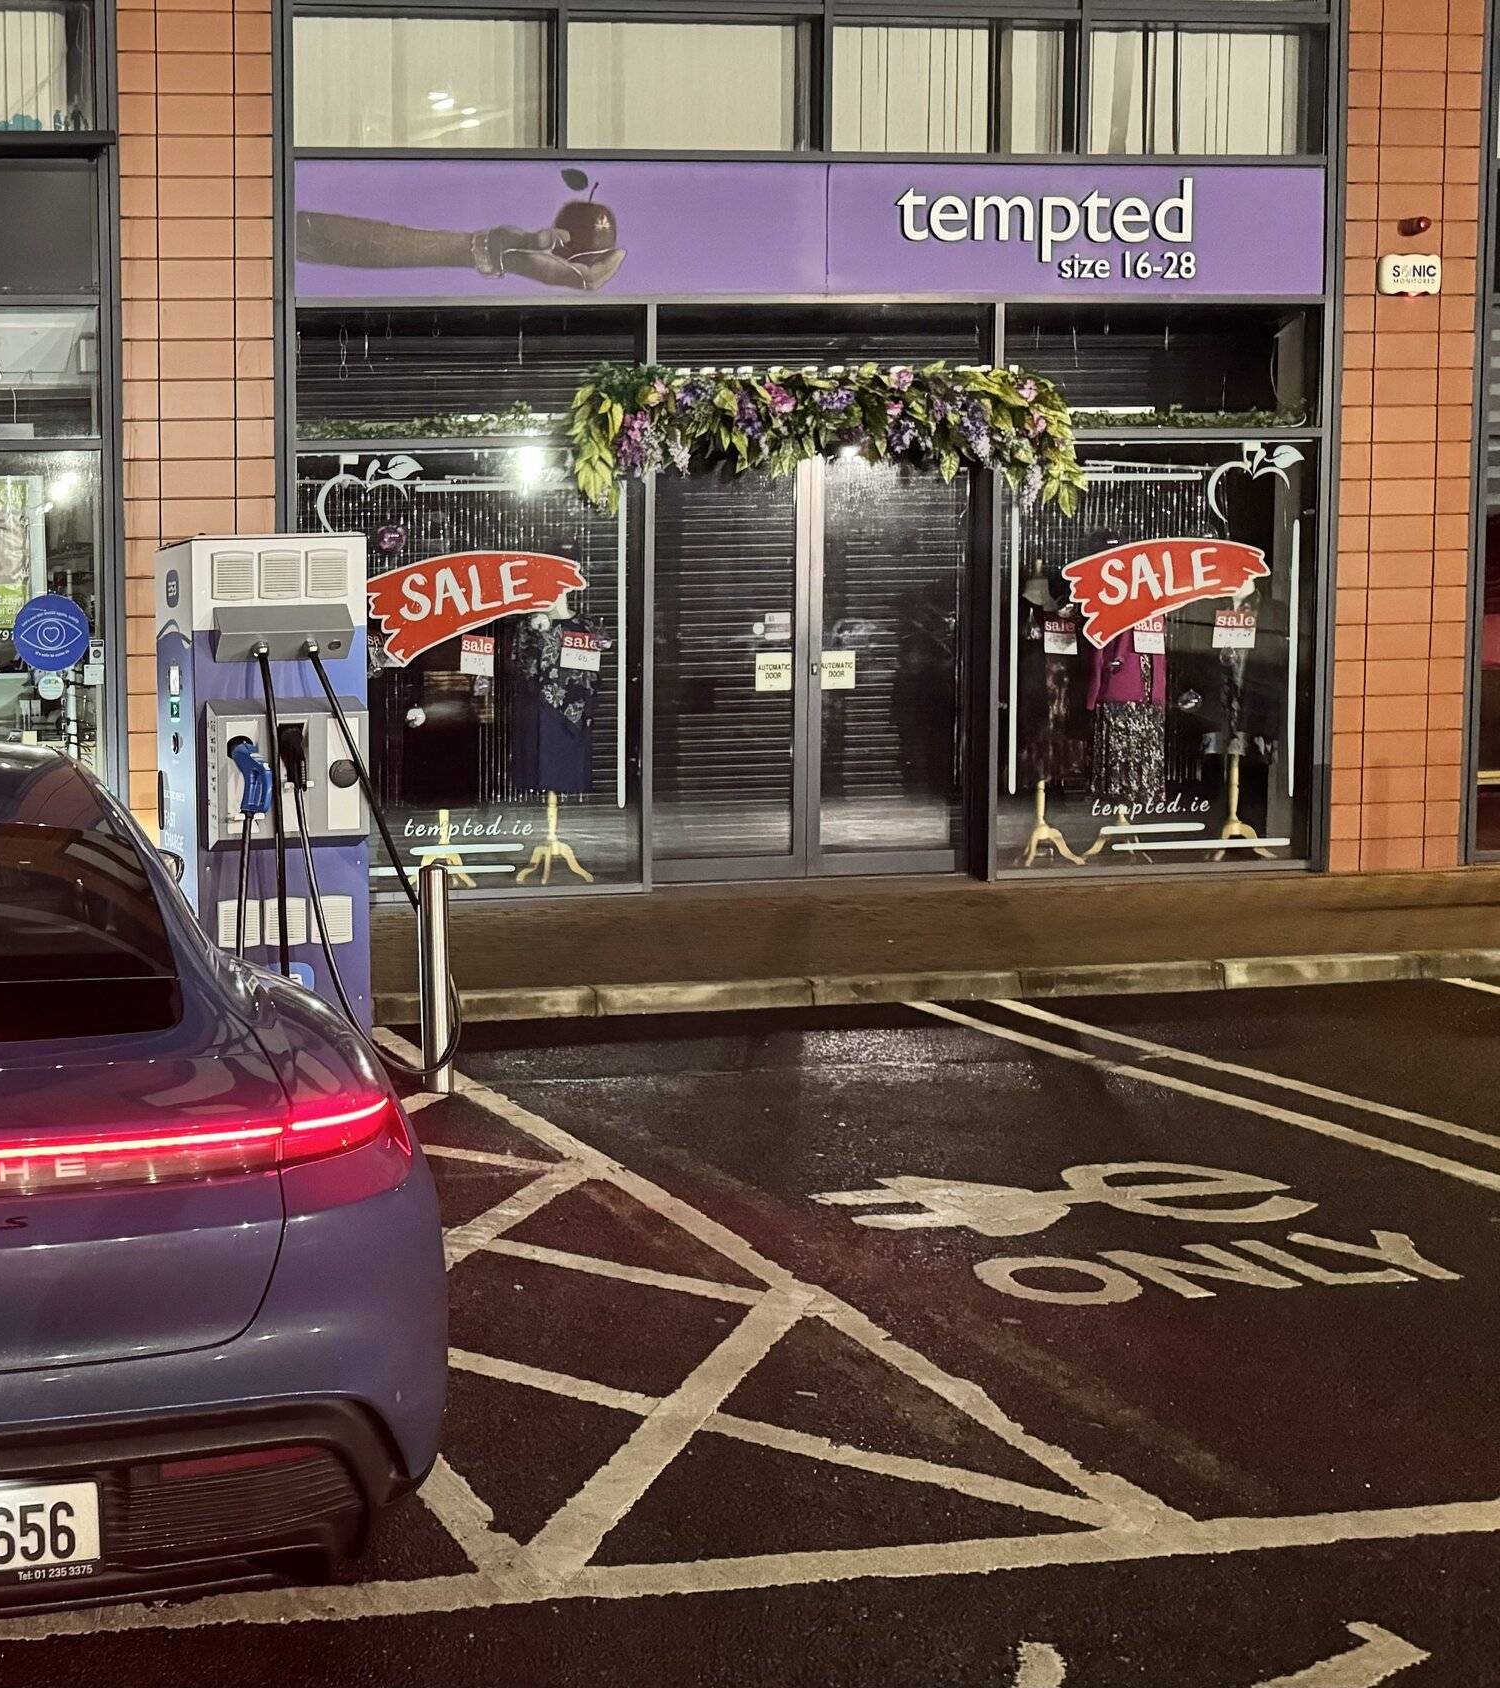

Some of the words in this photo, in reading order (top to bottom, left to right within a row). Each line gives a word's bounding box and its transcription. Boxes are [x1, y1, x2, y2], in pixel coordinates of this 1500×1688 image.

[895, 177, 1193, 263] tempted
[1059, 253, 1110, 279] size
[1122, 251, 1197, 279] 16-28
[1097, 547, 1222, 605] SALE
[399, 560, 533, 621] SALE
[1217, 613, 1256, 627] sale
[461, 638, 494, 653] sale
[758, 663, 791, 671] AUTOMATIC
[828, 670, 845, 678] DOOR
[1091, 793, 1211, 821] tempted.ie
[403, 814, 534, 841] tempted.ie
[973, 1230, 1464, 1305] ONLY
[35, 1569, 46, 1580] 01
[48, 1567, 68, 1578] 235
[68, 1565, 93, 1577] 3375
